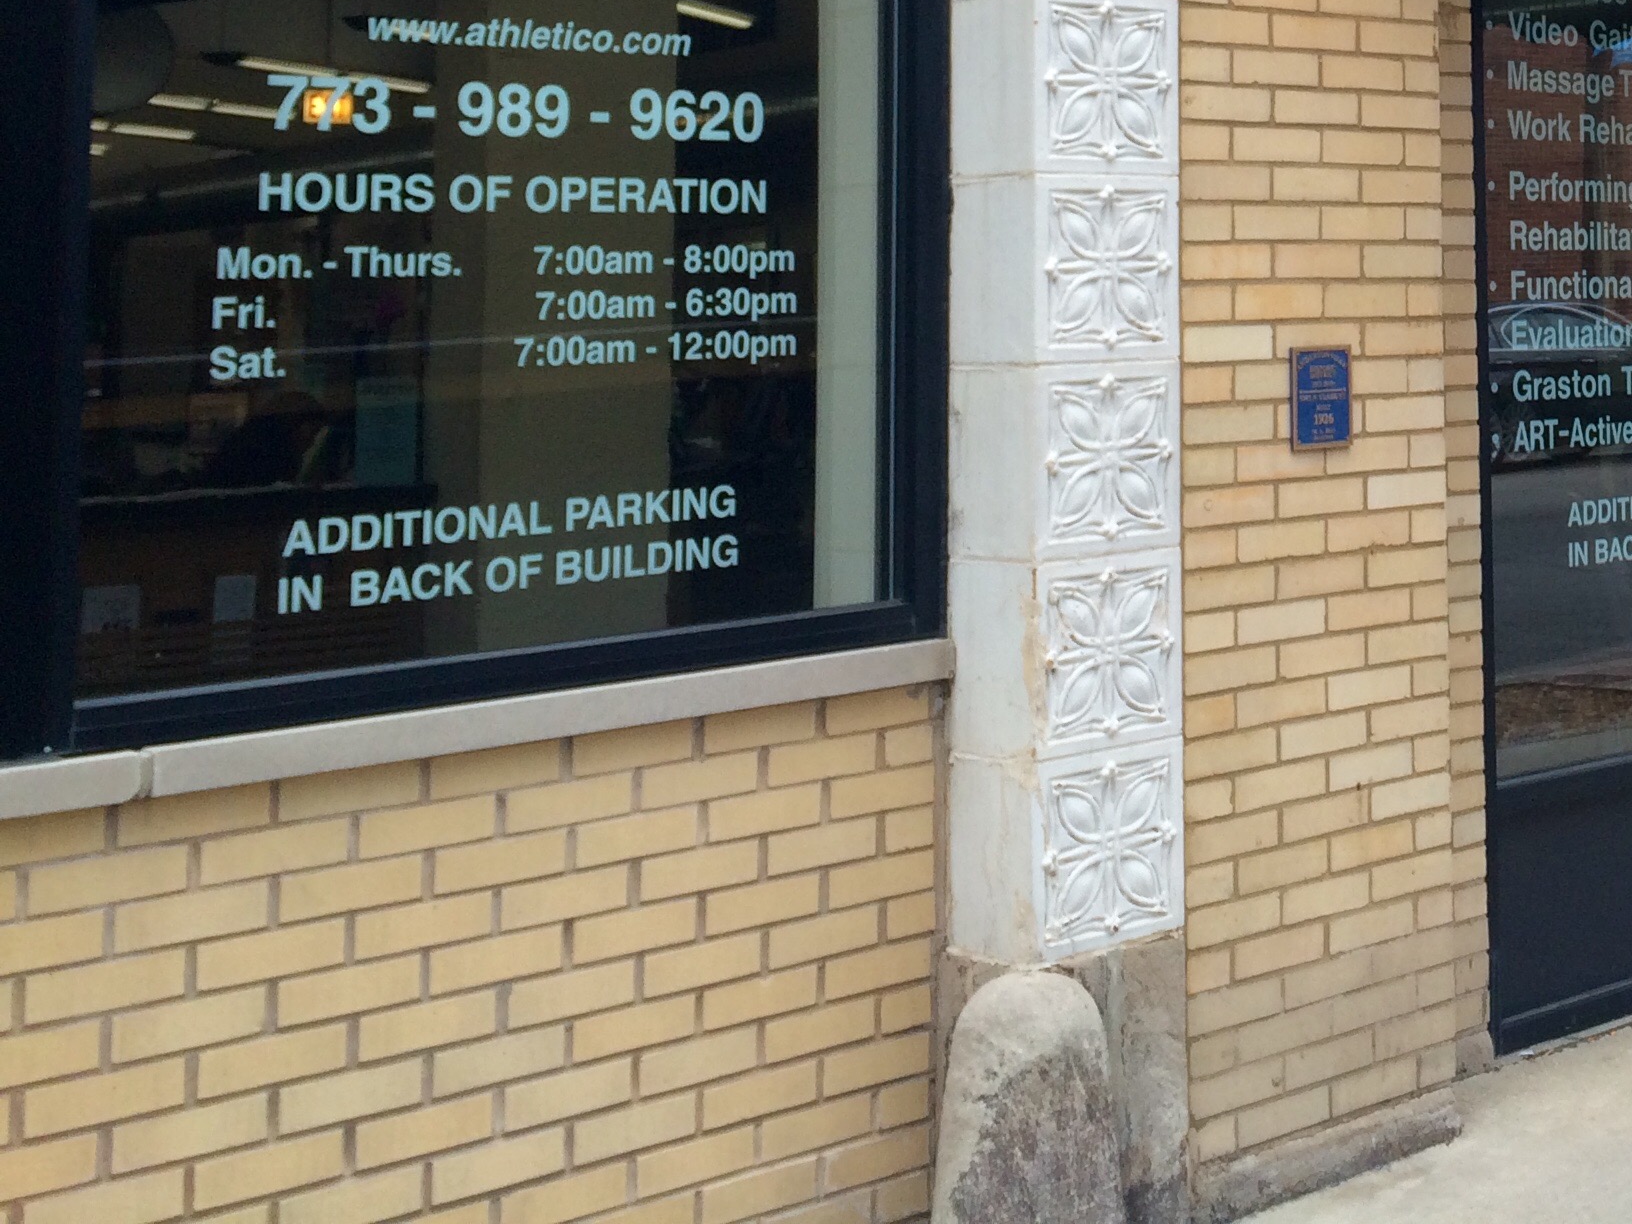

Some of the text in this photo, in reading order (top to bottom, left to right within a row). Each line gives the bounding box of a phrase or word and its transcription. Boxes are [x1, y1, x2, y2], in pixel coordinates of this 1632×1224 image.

[367, 15, 692, 56] www.athletico.com
[1508, 10, 1579, 47] Video
[1507, 61, 1615, 104] Massage
[267, 75, 391, 134] 773
[457, 82, 569, 139] 989
[630, 88, 764, 143] 9620
[1507, 109, 1571, 143] Work
[258, 173, 768, 214] HOURS OF OPERATION
[217, 247, 313, 279] Mon.
[345, 246, 462, 277] Thurs.
[534, 245, 654, 276] 7:00am
[684, 245, 796, 279] 8:00pm
[211, 297, 276, 330] Fri.
[536, 290, 656, 321] 7:00am
[685, 288, 797, 322] 6:30pm
[209, 347, 286, 380] Sat.
[514, 336, 636, 368] 7:00am
[668, 331, 797, 365] 12:00pm
[1512, 369, 1611, 402] Graston
[283, 485, 737, 558] ADDITIONAL PARKING
[1568, 540, 1588, 568] IN
[277, 535, 740, 615] IN BACK OF BUILDING
